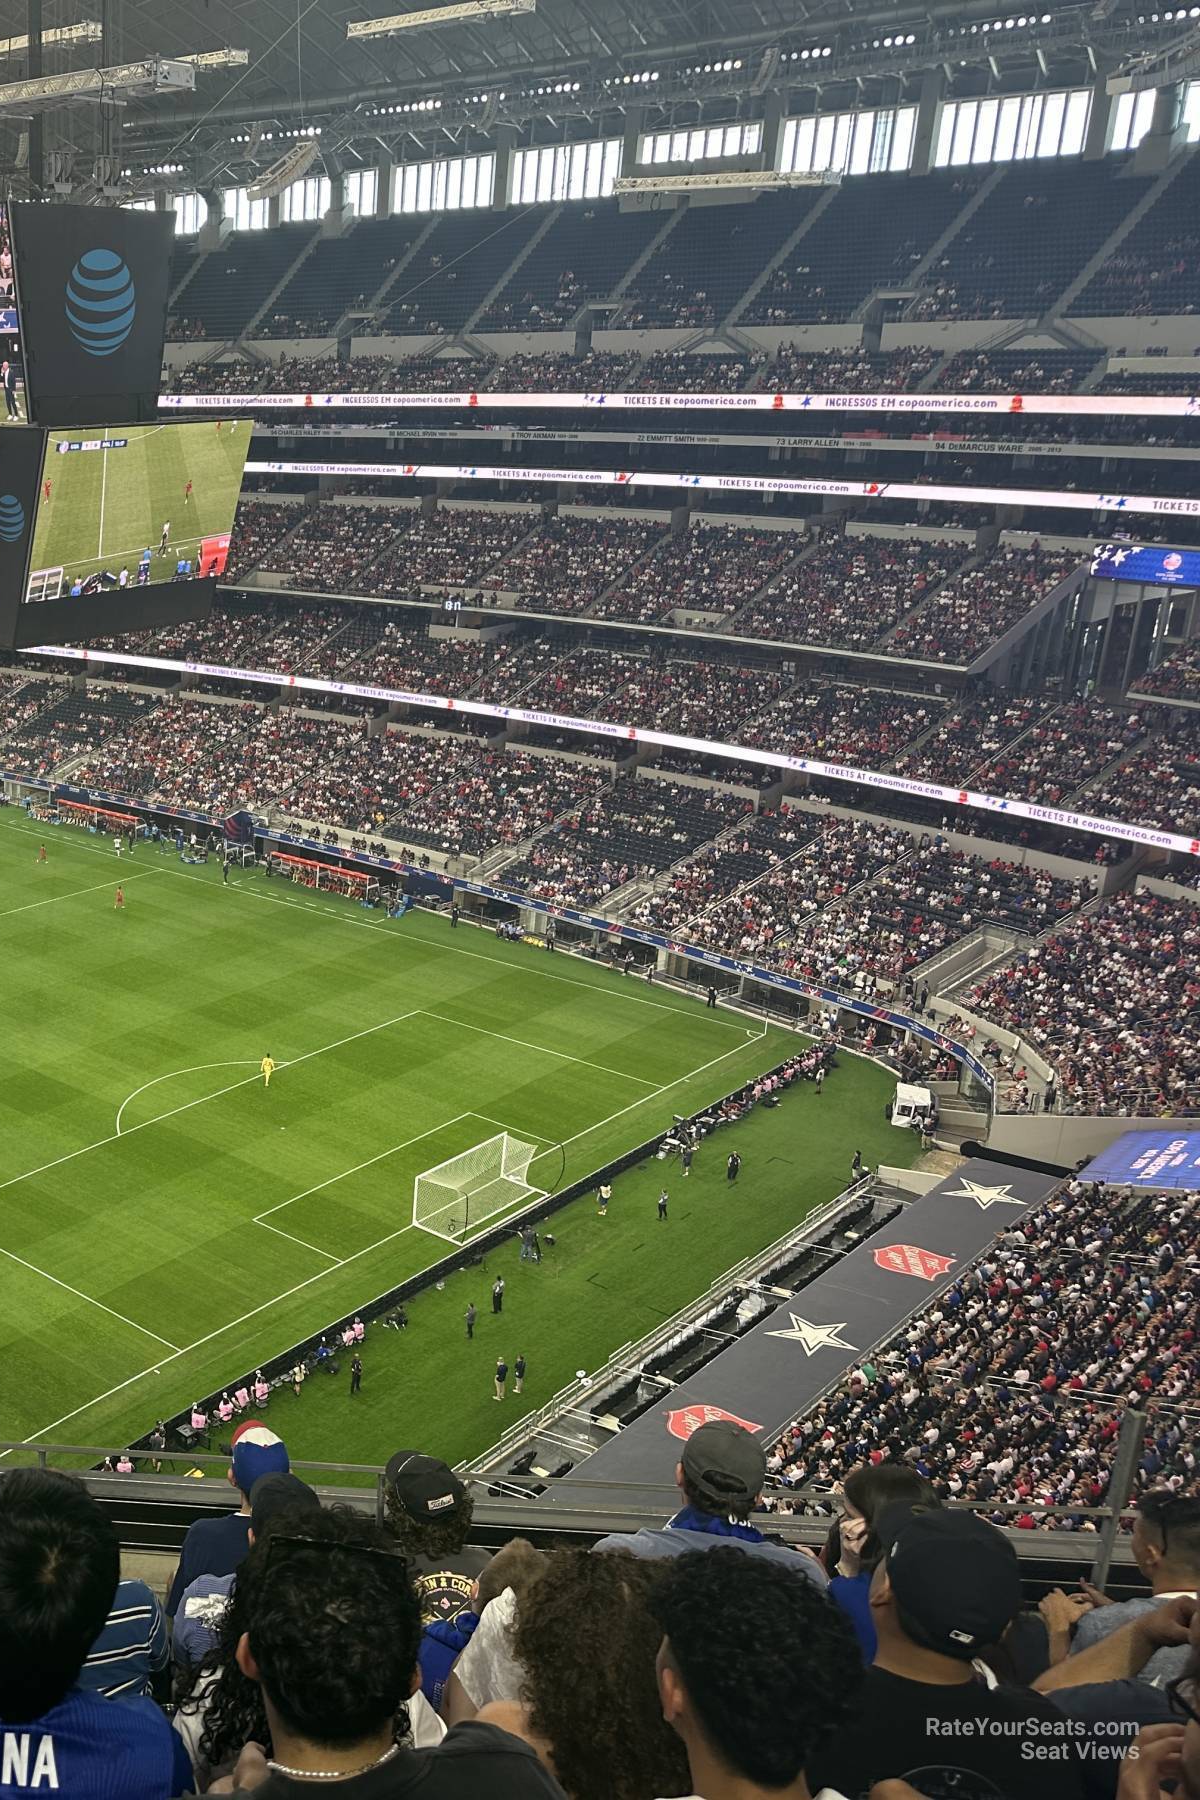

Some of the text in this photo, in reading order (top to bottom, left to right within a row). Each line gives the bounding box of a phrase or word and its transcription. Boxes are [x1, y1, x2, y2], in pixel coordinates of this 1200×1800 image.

[195, 397, 221, 405] TICKETS
[342, 396, 379, 404] INGRESSOS
[624, 396, 657, 405] TICKETS
[825, 398, 878, 408] INGRESSOS
[880, 398, 895, 407] EM
[814, 439, 839, 447] ALLEN
[935, 442, 945, 450] 94
[997, 444, 1024, 452] WARE
[492, 470, 521, 478] TICKETS
[522, 470, 530, 478] AT
[718, 478, 751, 488] TICKETS
[754, 480, 765, 488] EN
[1153, 501, 1199, 512] TICKETS
[522, 712, 549, 723] TICKETS
[823, 766, 855, 779] TICKETS
[856, 772, 866, 780] AT
[1028, 807, 1064, 822] TICKETS
[1067, 814, 1079, 825] EN
[440, 1578, 448, 1587] &
